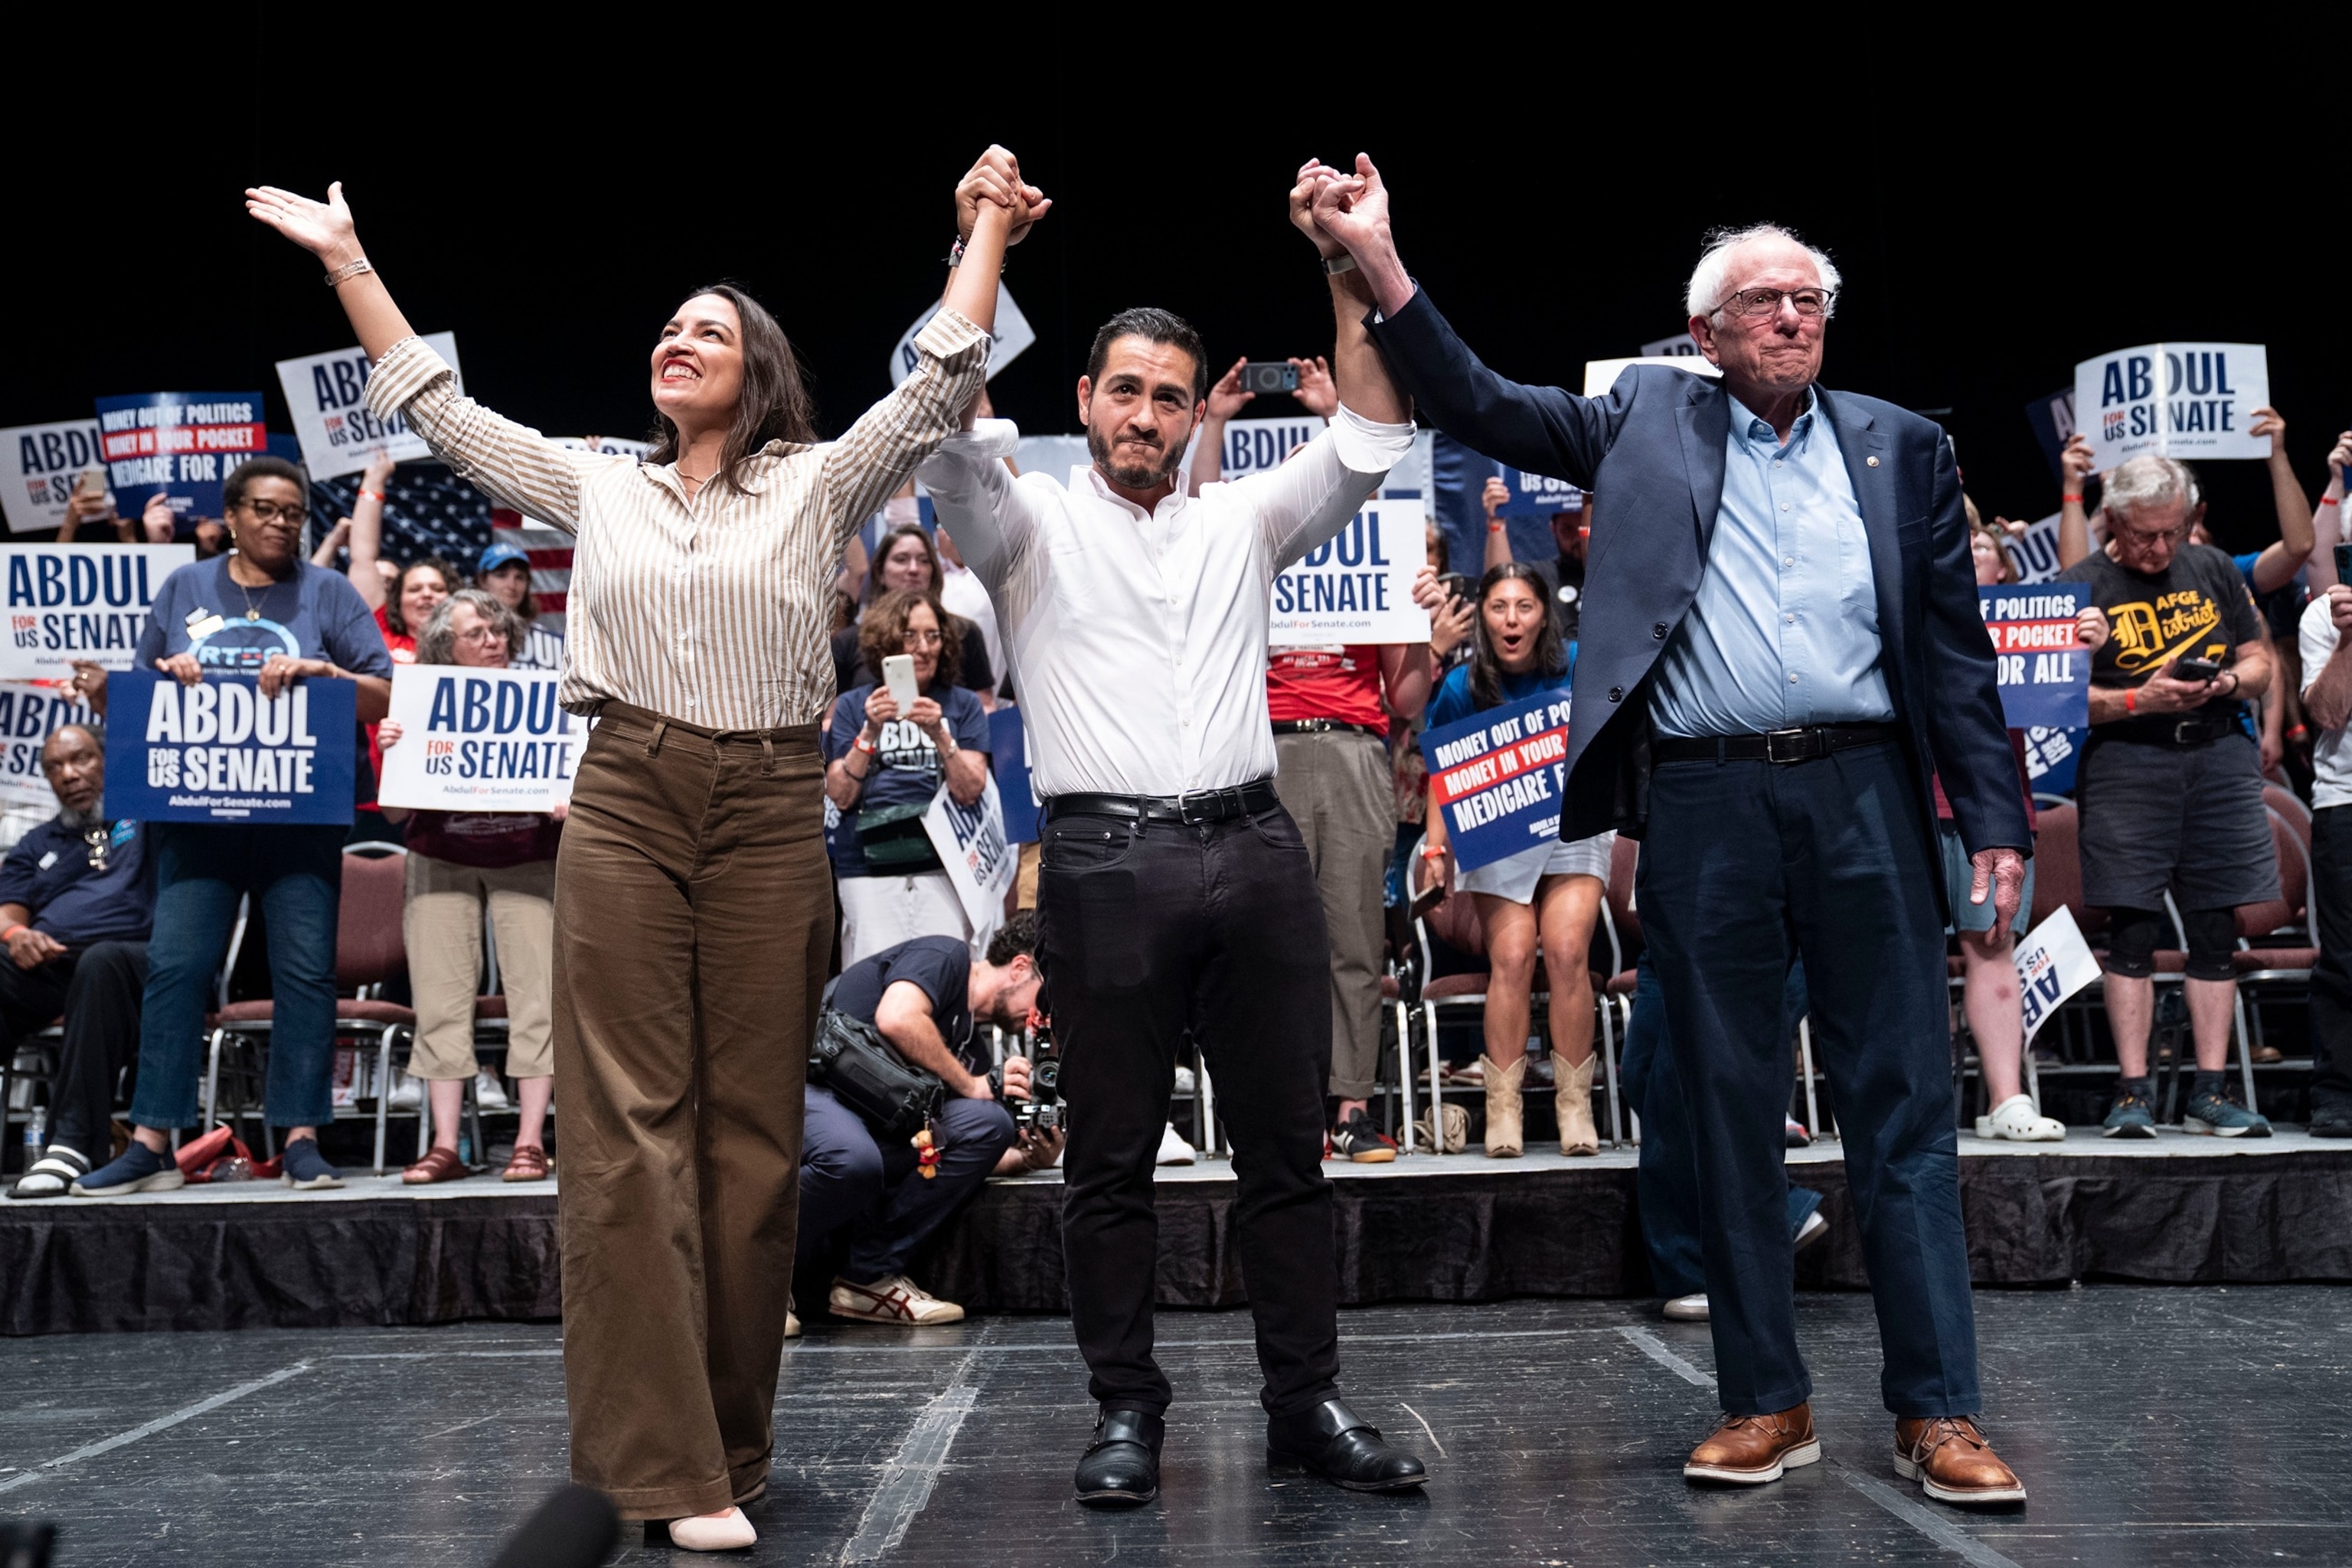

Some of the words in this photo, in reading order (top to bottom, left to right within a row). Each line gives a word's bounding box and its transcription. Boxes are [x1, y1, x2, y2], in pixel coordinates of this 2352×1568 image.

[103, 408, 136, 431] MONEY
[138, 408, 162, 426] OUT
[186, 402, 253, 426] POLITICS
[2102, 410, 2125, 426] FOR
[106, 433, 138, 456] MONEY
[139, 430, 153, 450] IN
[155, 427, 193, 452] YOUR
[197, 427, 253, 450] POCKET
[328, 428, 348, 446] US
[2105, 423, 2126, 442] US
[111, 456, 174, 488] MEDICARE
[179, 455, 217, 482] FOR
[30, 489, 53, 505] US
[9, 554, 154, 607] ABDUL
[1276, 573, 1390, 612] SENATE
[1995, 595, 2076, 620] POLITICS
[2156, 590, 2200, 611] AFGE
[12, 616, 37, 630] FOR
[43, 614, 149, 650] SENAT
[15, 630, 38, 648] US
[2006, 623, 2076, 648] POCKET
[2034, 653, 2074, 684] ALL
[146, 680, 317, 746] ABDUL
[426, 740, 454, 756] FOR
[1435, 730, 1489, 769] MONEY
[1491, 717, 1521, 747] OUT
[1524, 708, 1545, 735] OF
[149, 747, 180, 766] FOR
[426, 756, 452, 775] US
[459, 740, 574, 779] SENATE
[1444, 756, 1498, 797] MONEY
[1498, 749, 1519, 775] IN
[1518, 733, 1566, 766] YOUR
[147, 766, 181, 789] US
[183, 746, 315, 794] SENATE
[168, 795, 292, 808] AbdulForSenate.com
[443, 785, 550, 795] AbdulForSenate.com
[1452, 769, 1552, 834] MEDICARE
[2027, 946, 2046, 969] US
[2031, 956, 2050, 976] FOR
